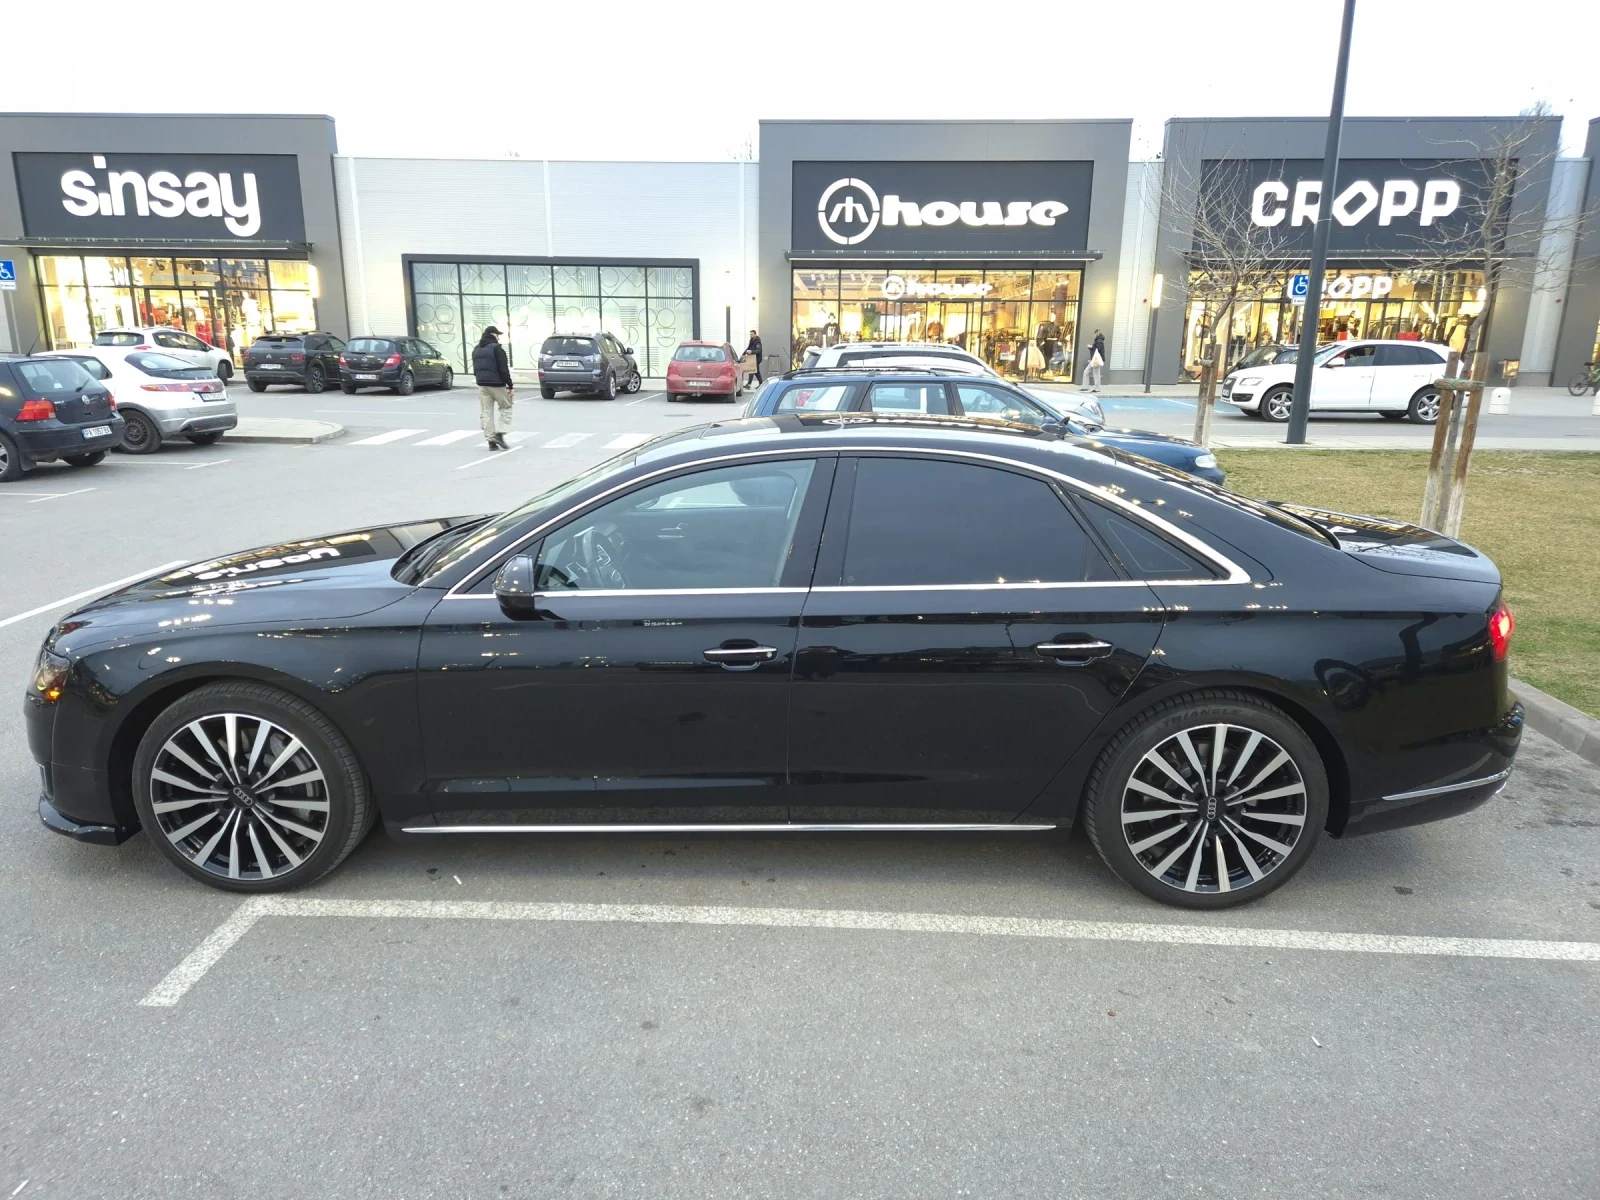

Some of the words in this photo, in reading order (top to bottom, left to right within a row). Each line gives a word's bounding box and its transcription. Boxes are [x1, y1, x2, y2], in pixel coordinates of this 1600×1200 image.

[60, 155, 261, 238] sinsay
[882, 194, 1069, 227] house
[1251, 180, 1461, 226] CROPP
[1162, 708, 1243, 727] TRIANGLE
